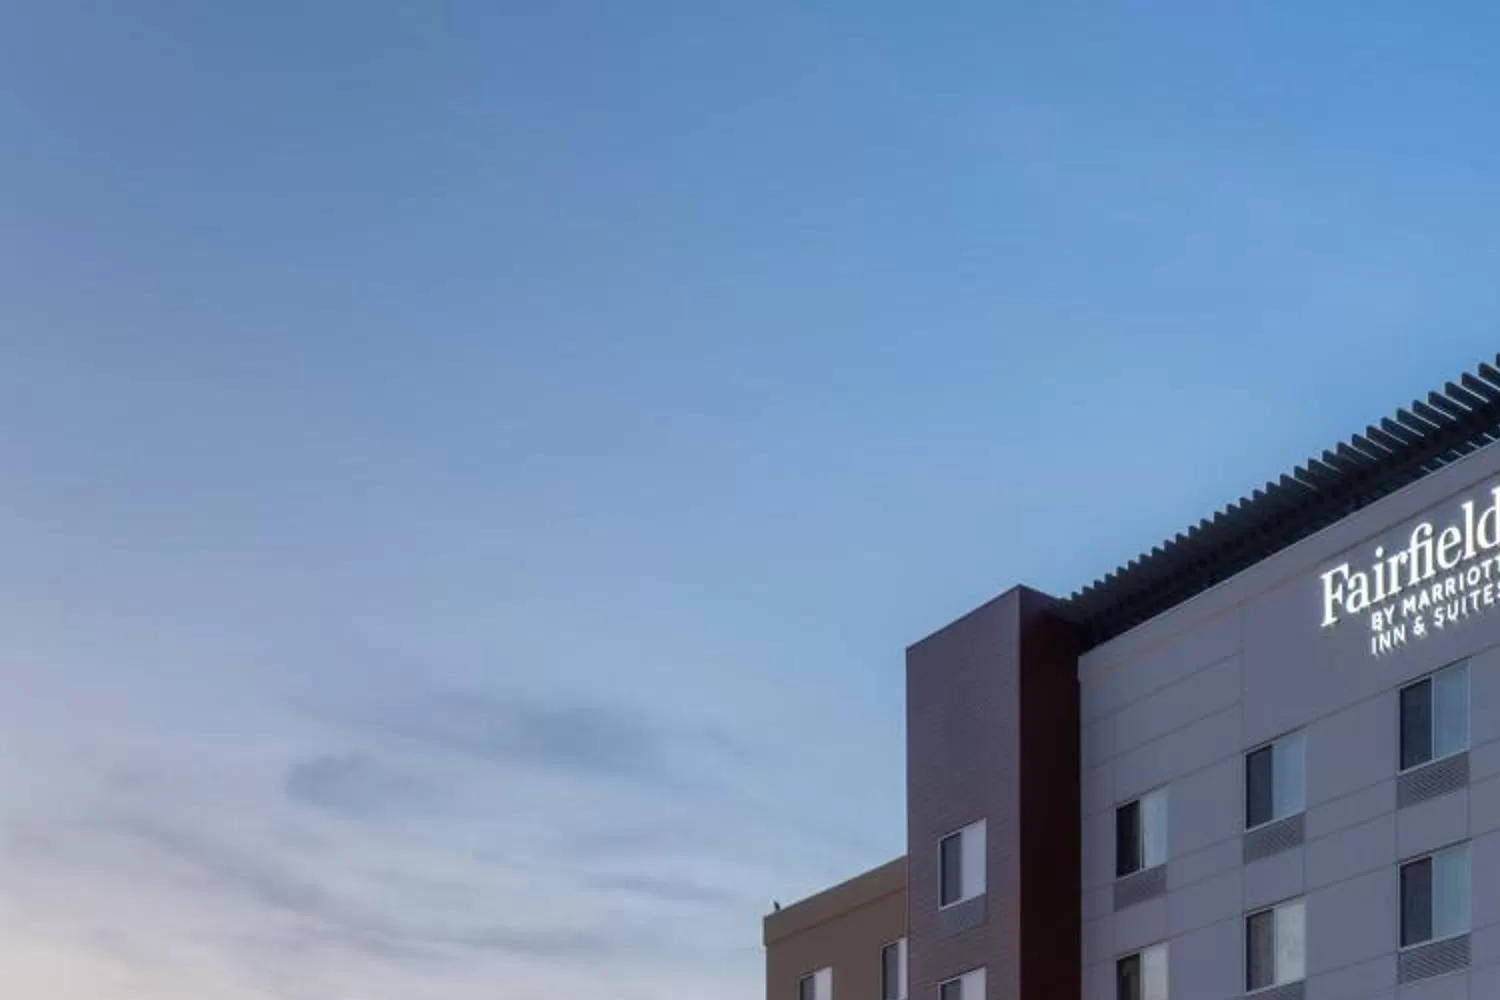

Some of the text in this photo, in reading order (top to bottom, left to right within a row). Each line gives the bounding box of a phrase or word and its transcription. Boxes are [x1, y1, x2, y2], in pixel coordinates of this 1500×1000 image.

[1371, 605, 1396, 631] BY
[1371, 623, 1407, 655] INN
[1413, 615, 1425, 636] &
